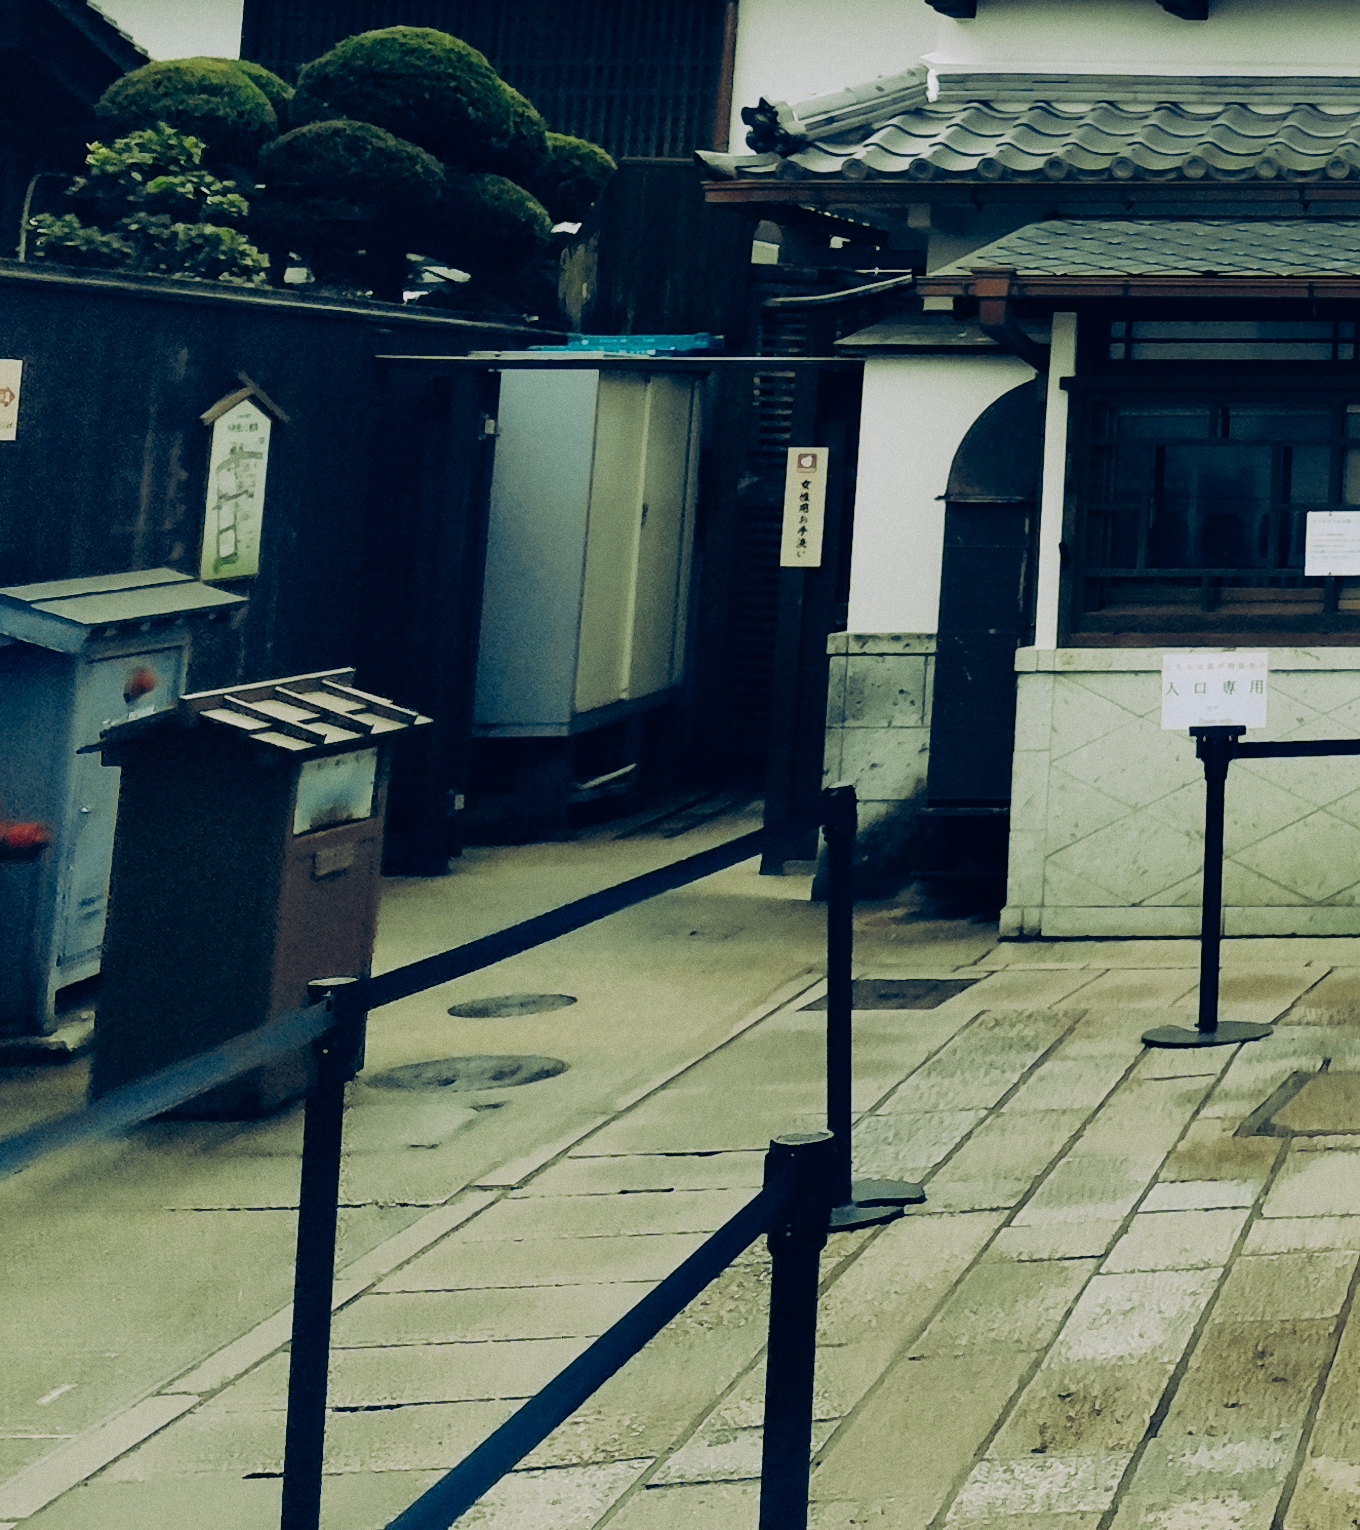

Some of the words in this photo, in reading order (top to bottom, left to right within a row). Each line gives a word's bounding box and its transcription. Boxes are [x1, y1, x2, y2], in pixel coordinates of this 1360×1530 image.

[796, 479, 811, 558] 女性用お手洗い
[1165, 679, 1265, 697] 入口専用
